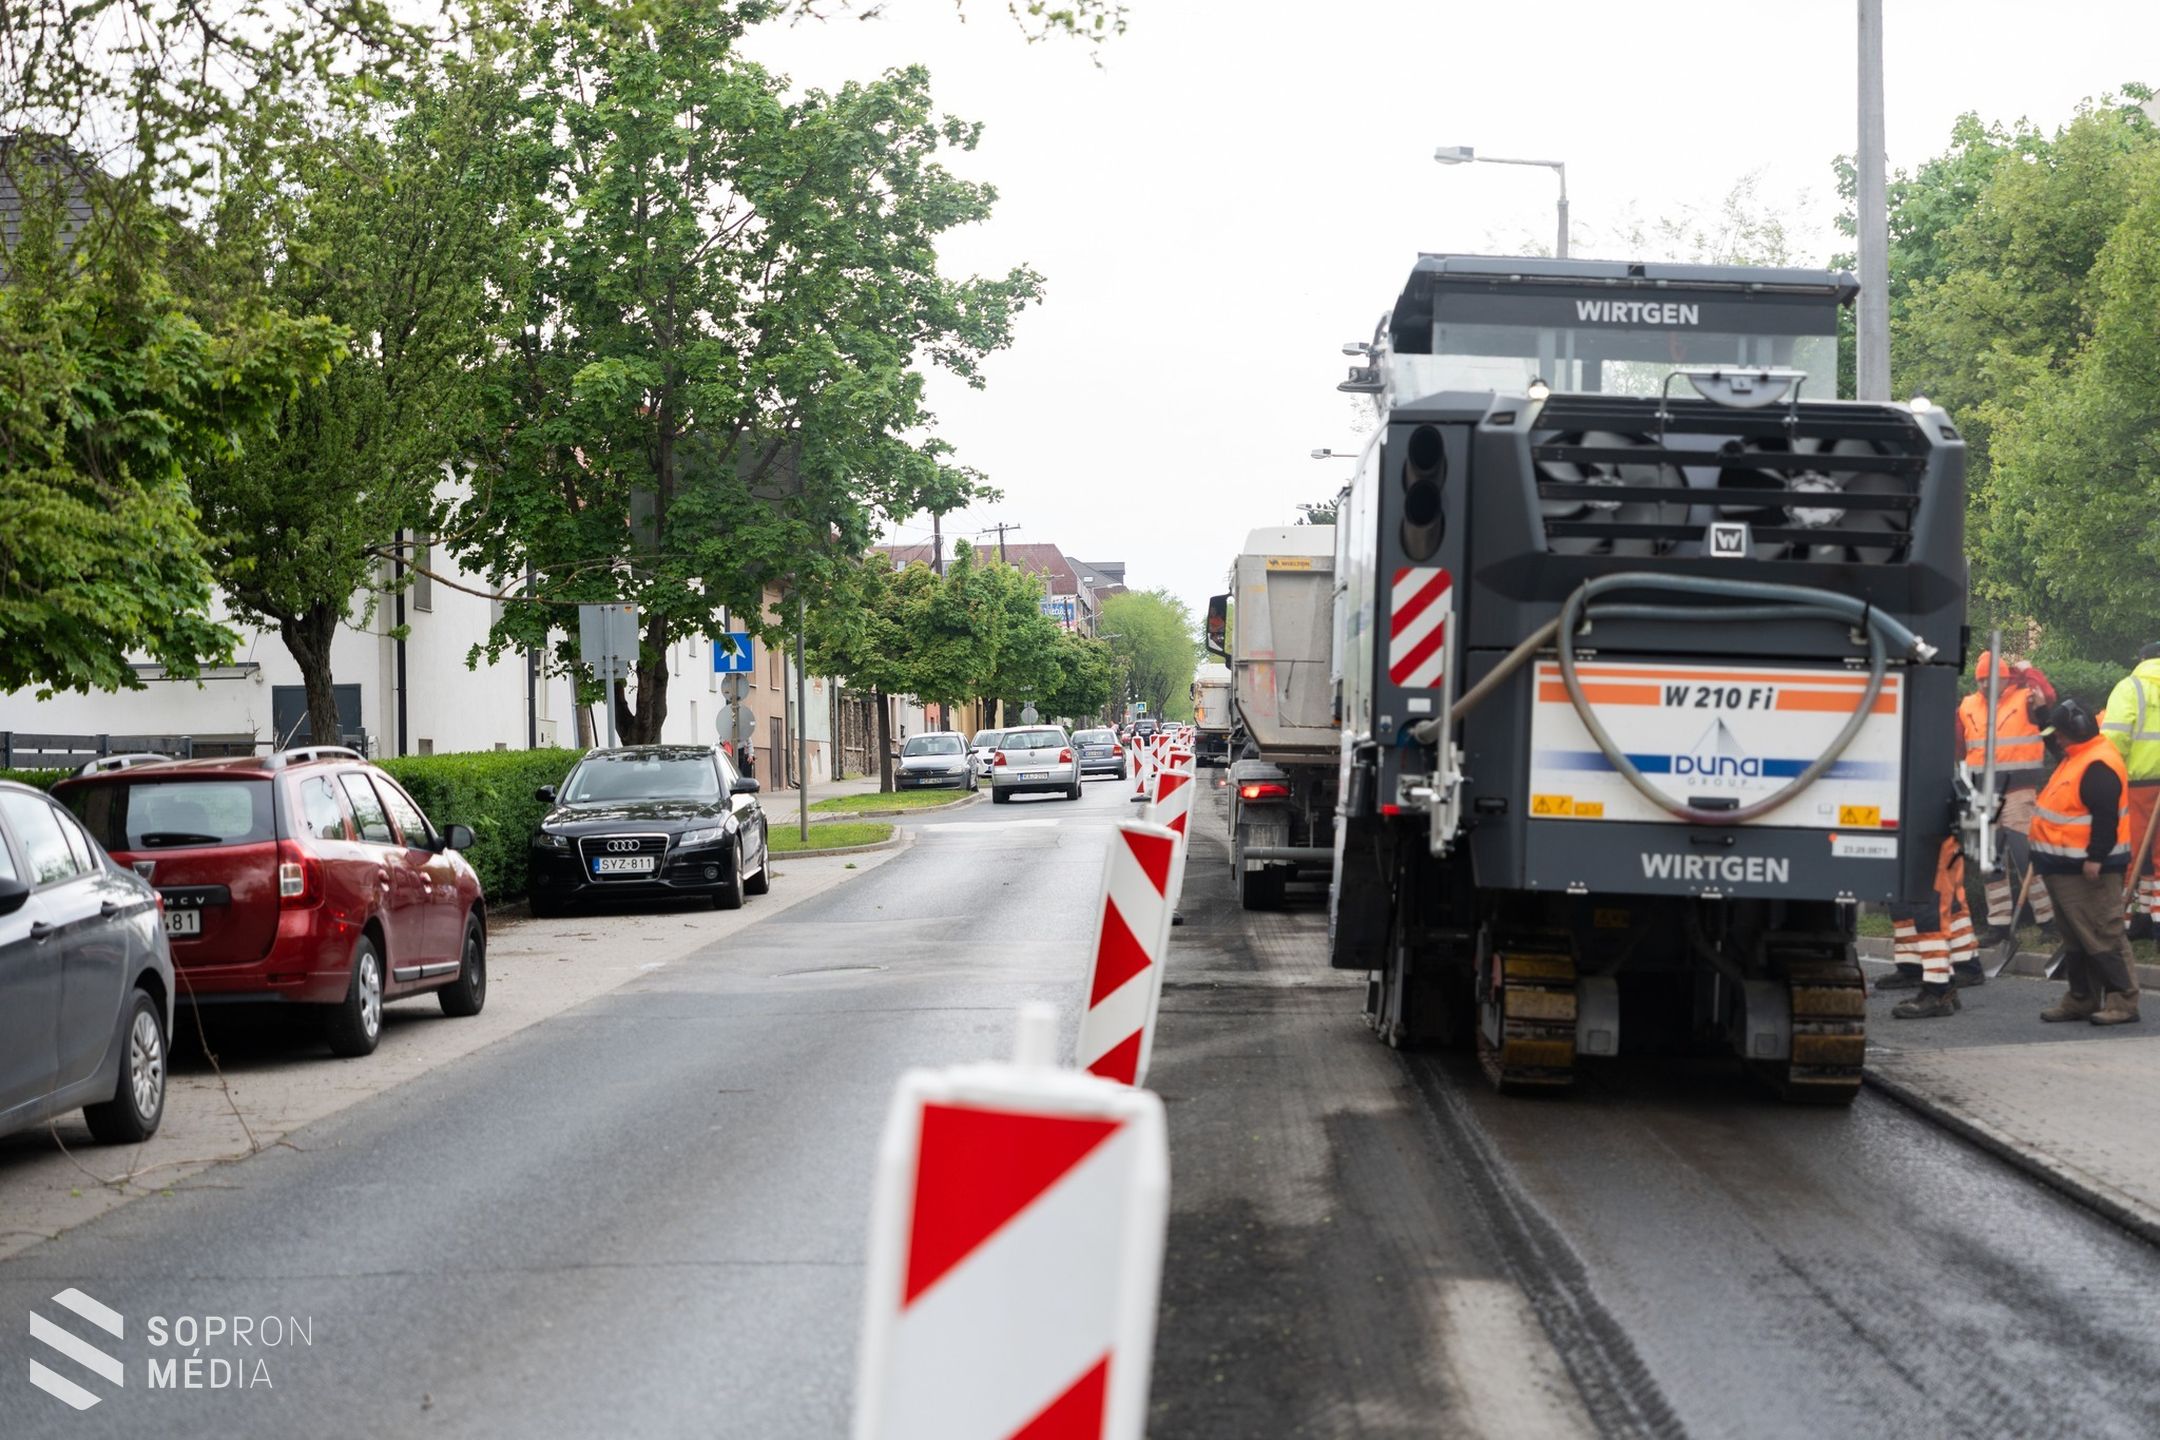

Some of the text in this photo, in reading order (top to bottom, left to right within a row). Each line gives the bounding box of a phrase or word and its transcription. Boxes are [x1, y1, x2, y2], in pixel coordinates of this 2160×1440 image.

[1576, 300, 1699, 325] WIRTGEN
[1716, 530, 1741, 550] W
[1665, 685, 1774, 710] W 210 Fi
[1687, 777, 1748, 787] GROUP
[602, 858, 651, 870] SYZ-811
[1641, 852, 1790, 883] WIRTGEN
